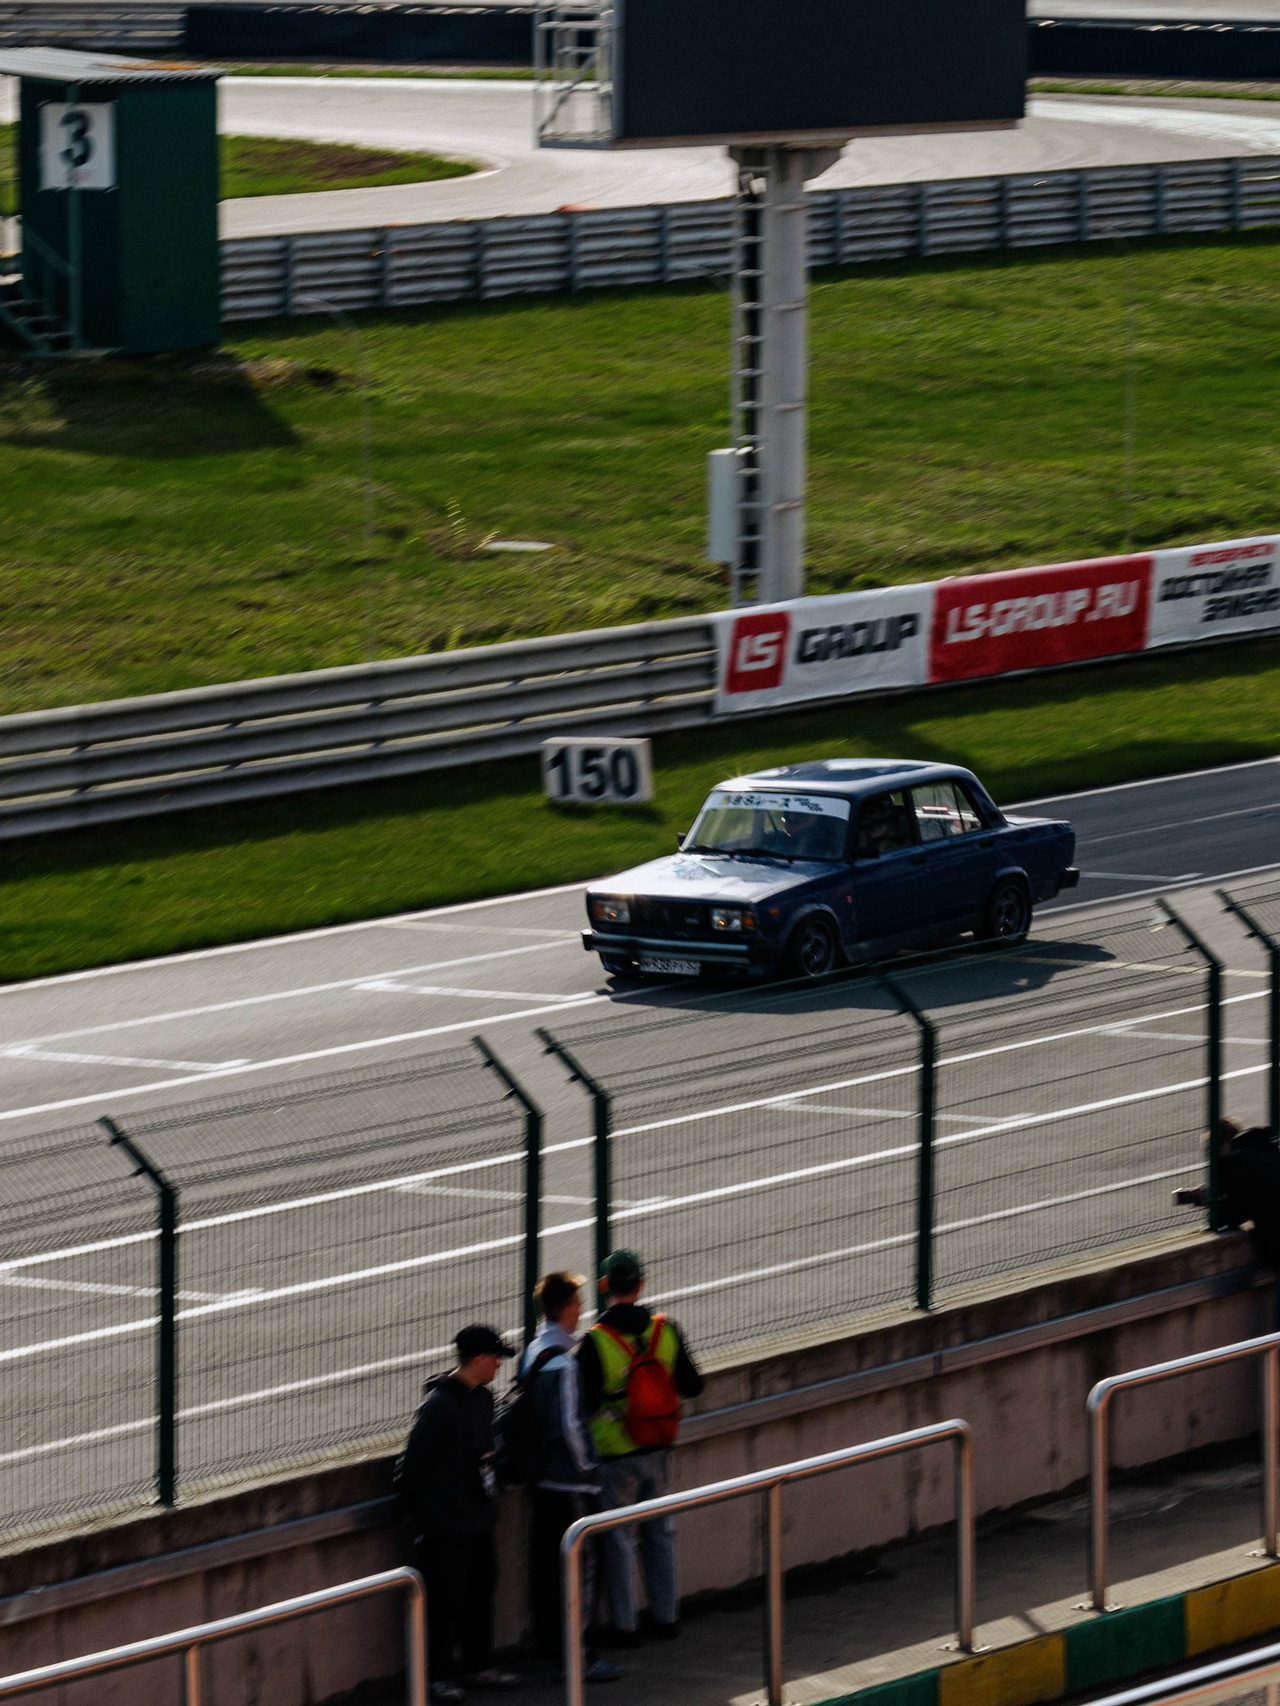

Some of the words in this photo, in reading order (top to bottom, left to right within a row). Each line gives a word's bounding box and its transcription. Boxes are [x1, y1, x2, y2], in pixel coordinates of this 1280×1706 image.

[59, 109, 92, 168] 3
[796, 612, 920, 664] GROUP
[545, 746, 639, 798] 150
